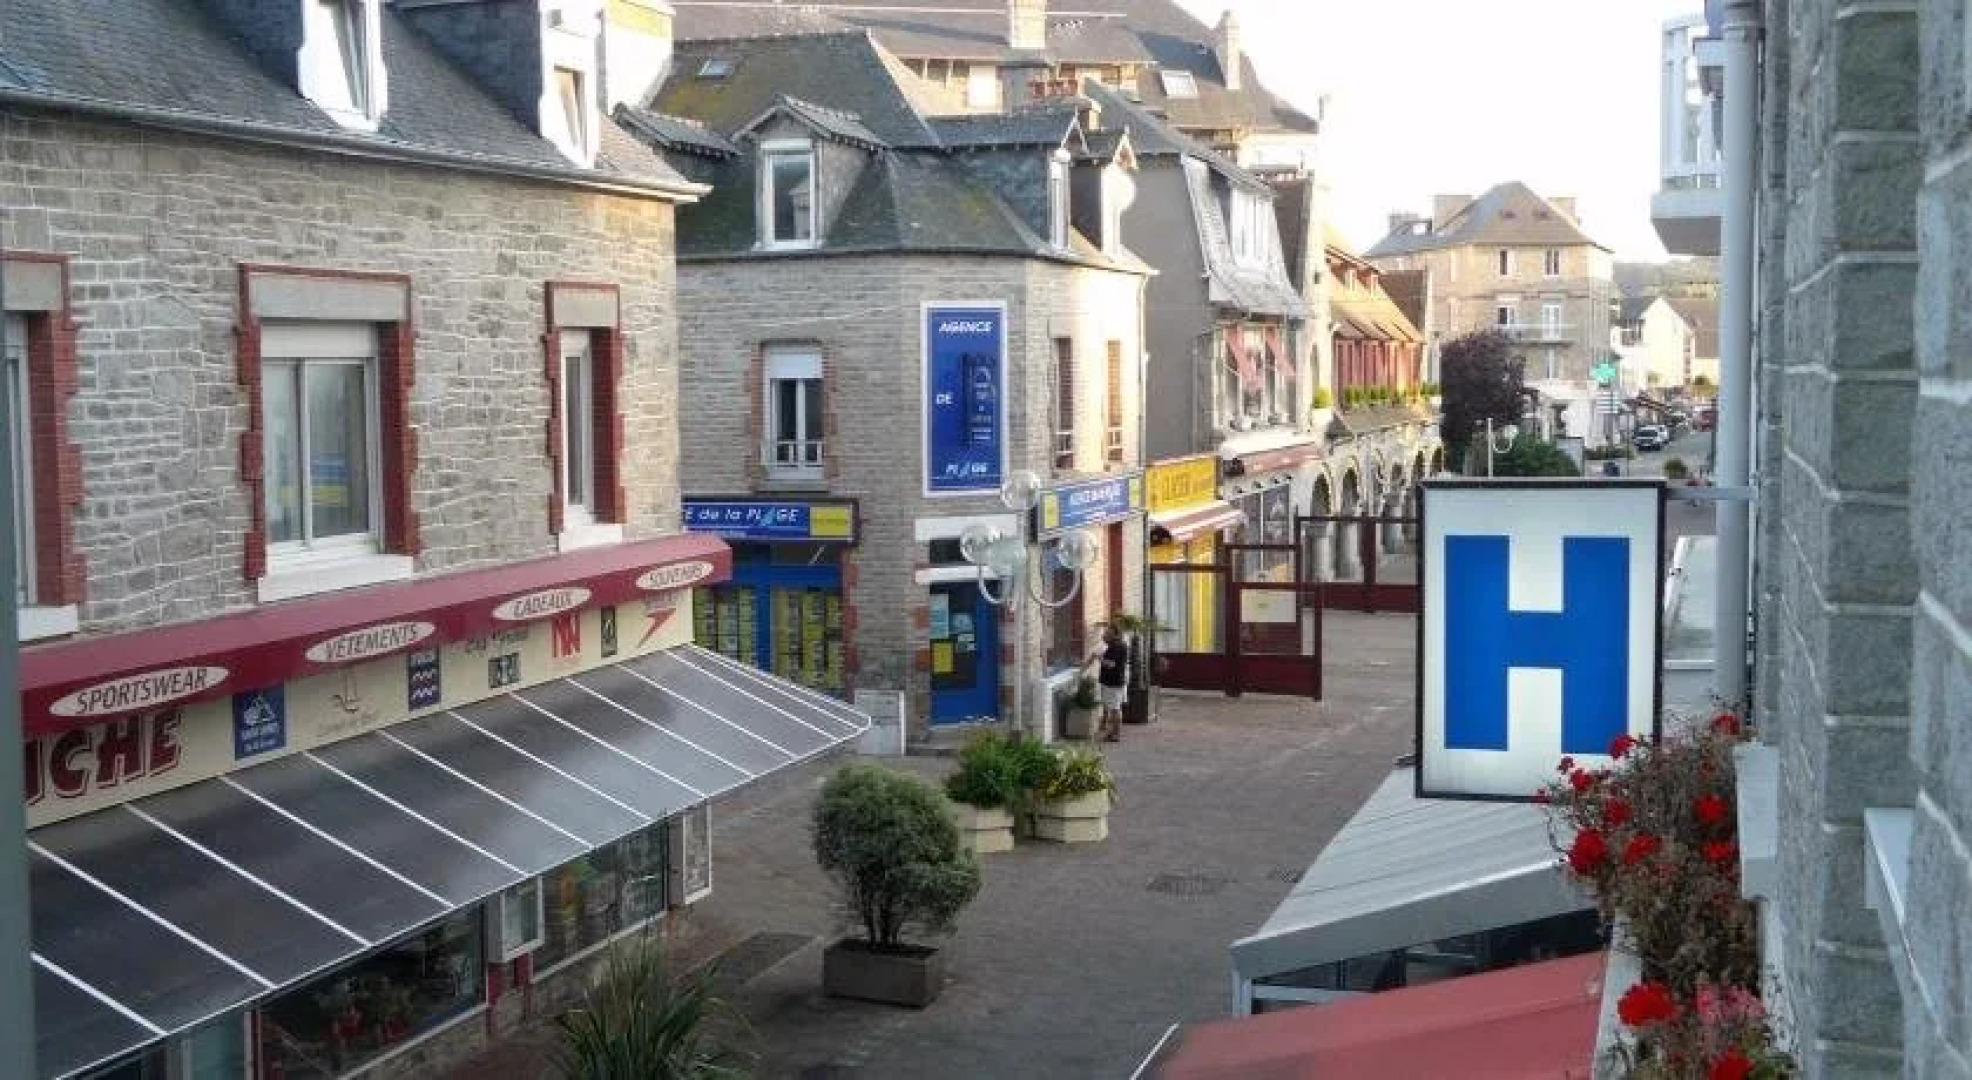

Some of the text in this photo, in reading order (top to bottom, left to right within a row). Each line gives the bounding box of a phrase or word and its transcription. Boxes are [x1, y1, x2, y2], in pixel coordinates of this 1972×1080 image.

[939, 321, 993, 333] AGENCE
[936, 393, 954, 405] DE
[700, 508, 719, 520] de
[725, 508, 742, 520] la
[513, 591, 573, 615] CADEAUX
[1444, 535, 1630, 756] H
[75, 667, 208, 715] SPORTSWEAR
